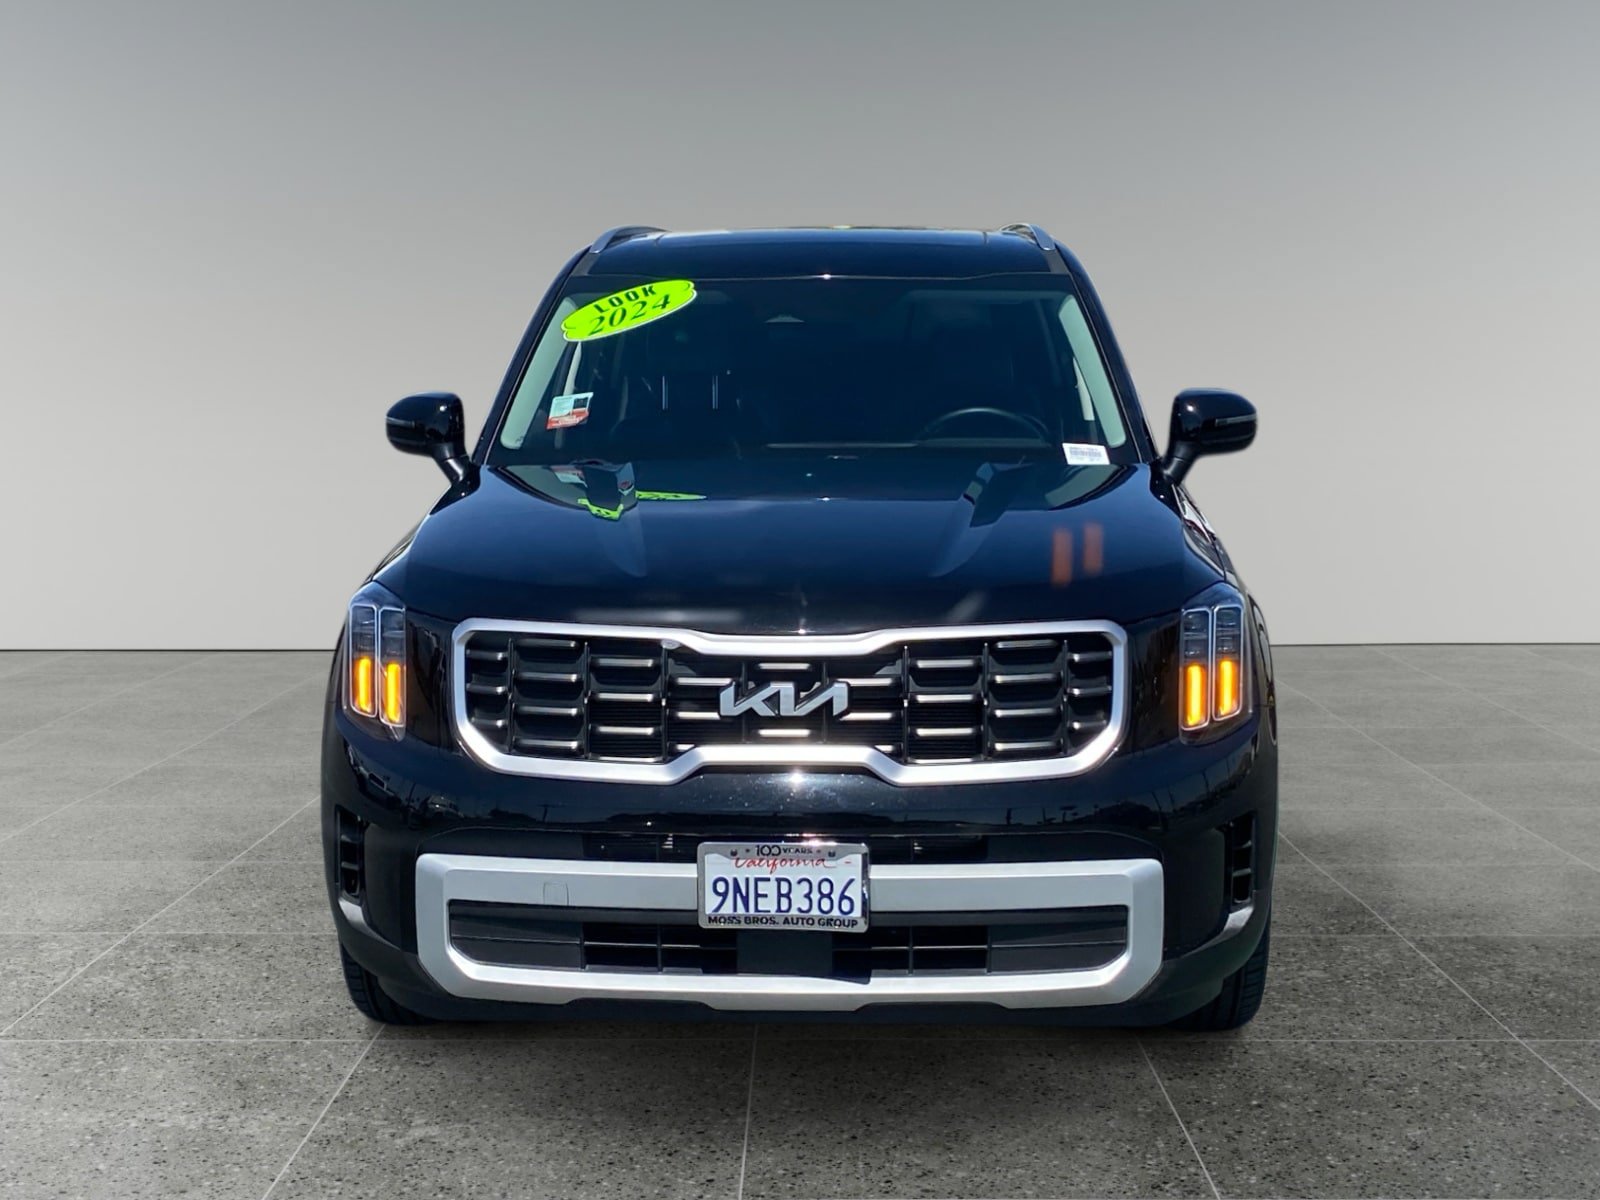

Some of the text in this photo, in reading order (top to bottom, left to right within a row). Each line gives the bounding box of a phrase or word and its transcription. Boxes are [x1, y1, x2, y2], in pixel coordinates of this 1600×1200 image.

[587, 294, 670, 336] 2024
[593, 285, 656, 314] LOOK
[720, 681, 848, 716] KIA
[756, 845, 781, 857] 100
[712, 876, 855, 916] 9NEB386
[708, 915, 858, 928] MOSS BROS. AUTO GROUP
